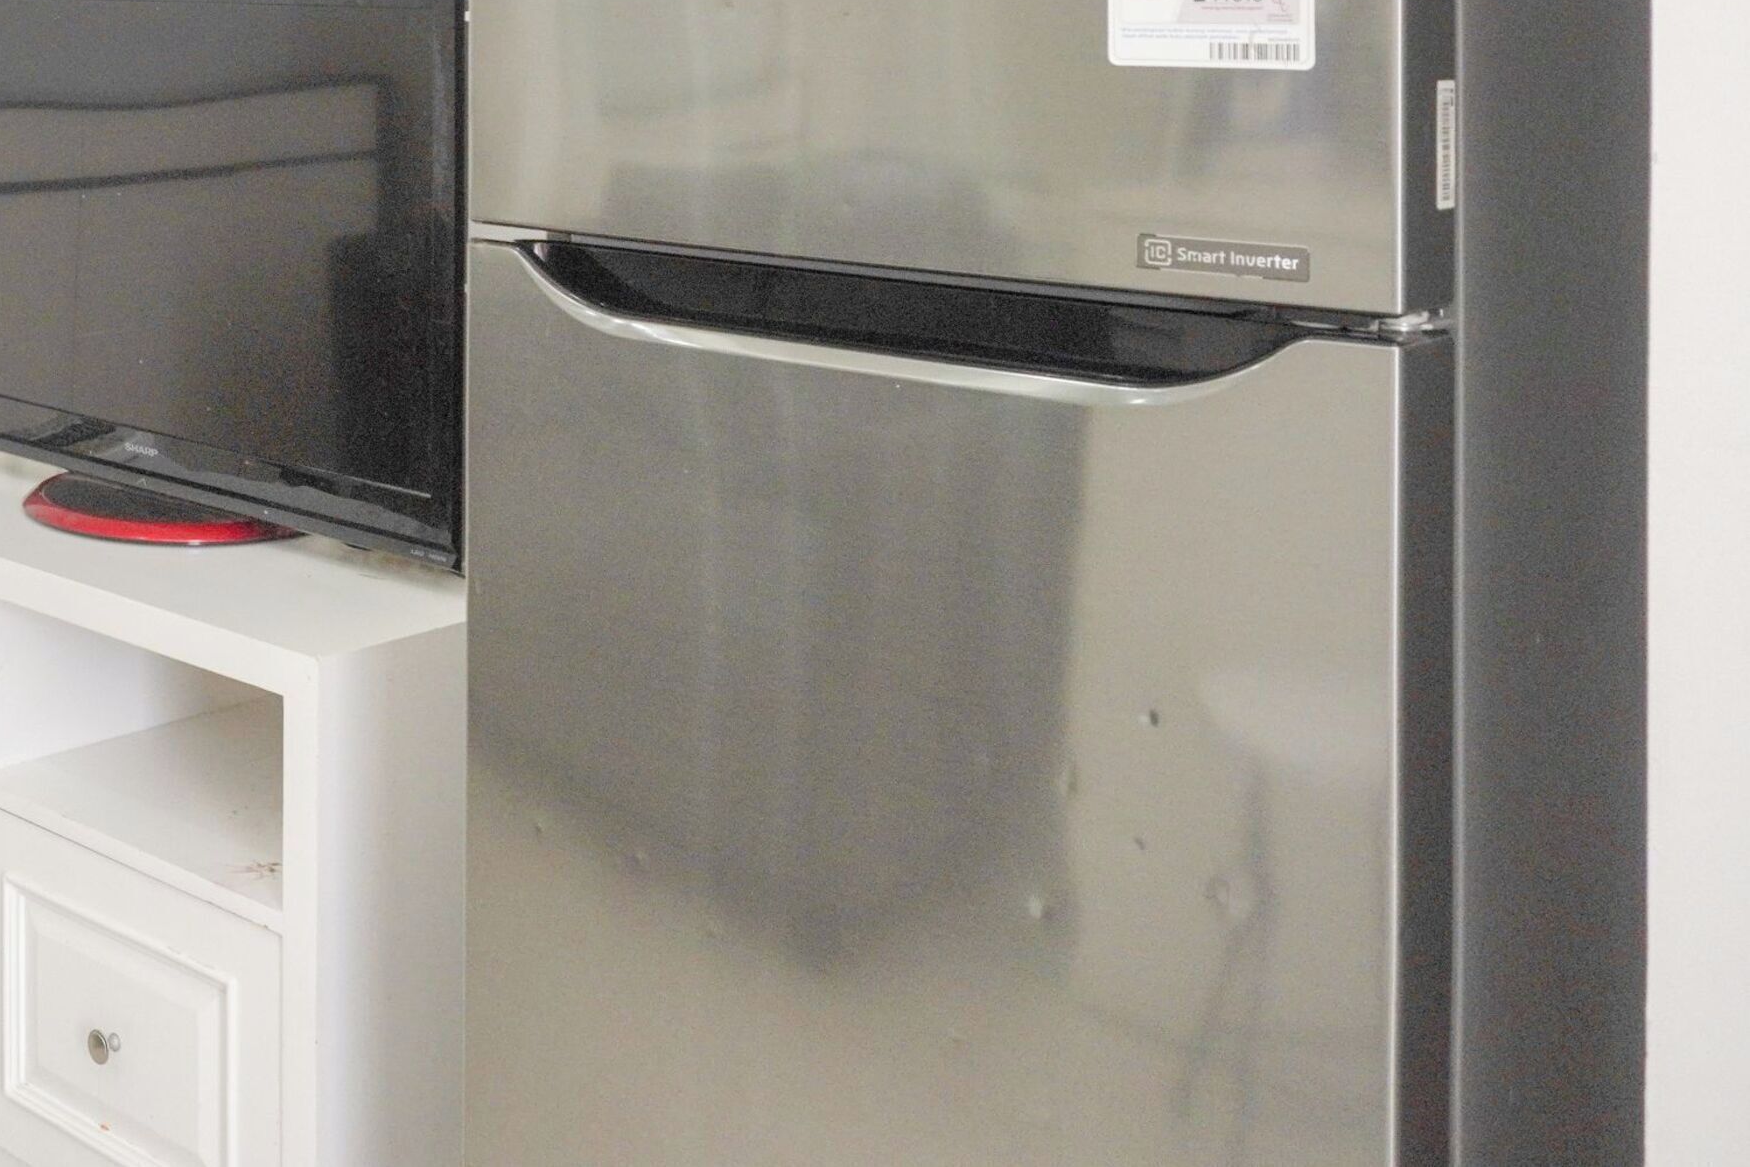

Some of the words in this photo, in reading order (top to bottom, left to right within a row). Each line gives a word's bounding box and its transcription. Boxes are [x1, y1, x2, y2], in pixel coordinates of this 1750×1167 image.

[1177, 247, 1226, 265] Smart
[1231, 251, 1299, 271] Inverter
[124, 442, 159, 457] SHARP
